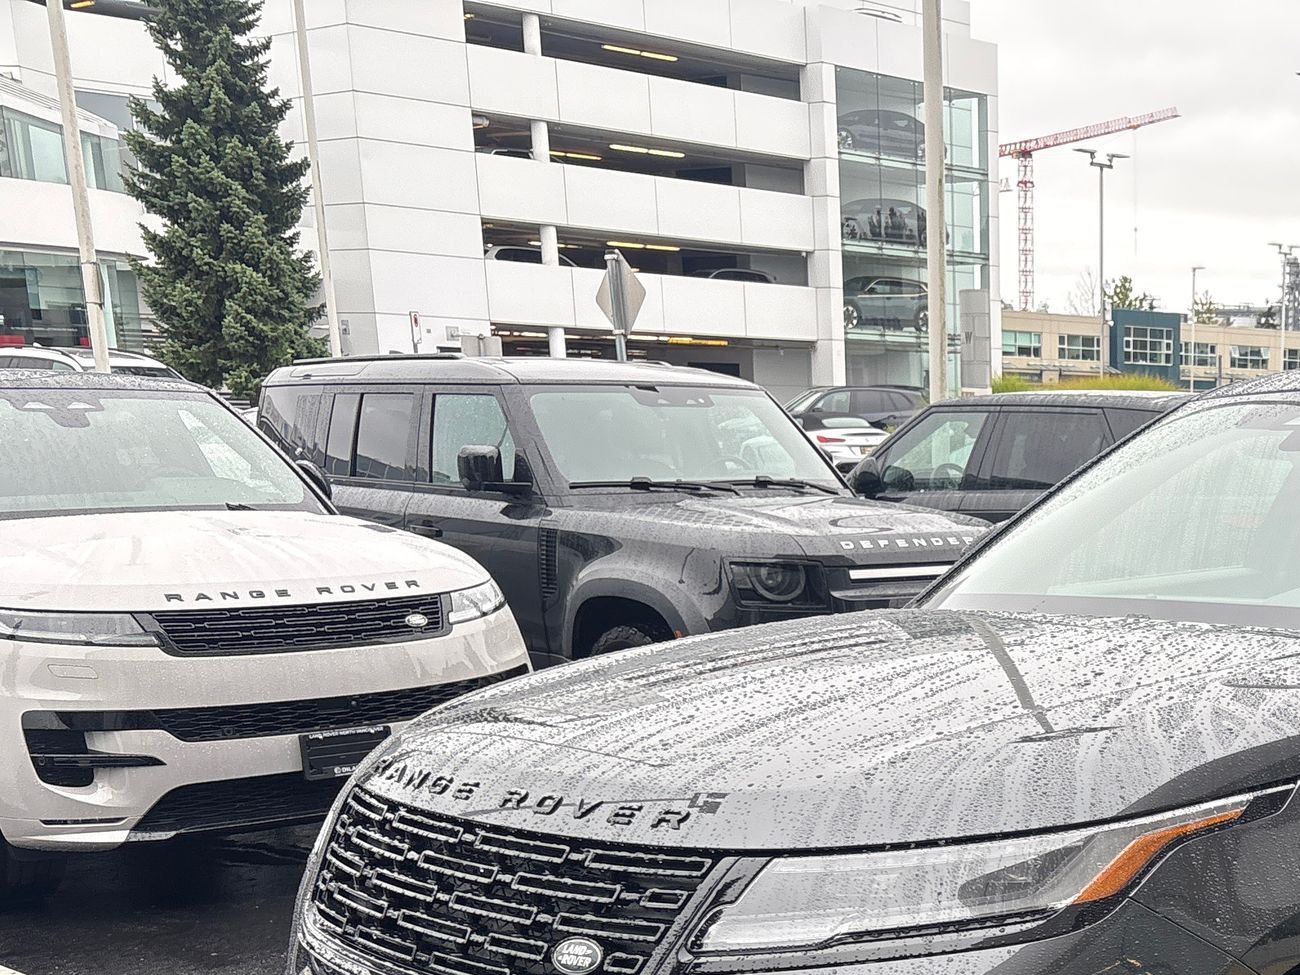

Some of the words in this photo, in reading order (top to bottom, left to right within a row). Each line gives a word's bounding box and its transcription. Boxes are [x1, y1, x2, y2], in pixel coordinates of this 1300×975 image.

[840, 536, 974, 550] DEFENDER
[164, 589, 291, 602] RANGE
[316, 580, 421, 595] ROVER
[341, 765, 358, 773] DILA
[374, 757, 481, 801] RANGE
[499, 787, 691, 831] ROVER
[562, 943, 589, 956] LAND
[560, 953, 592, 968] ROVER
